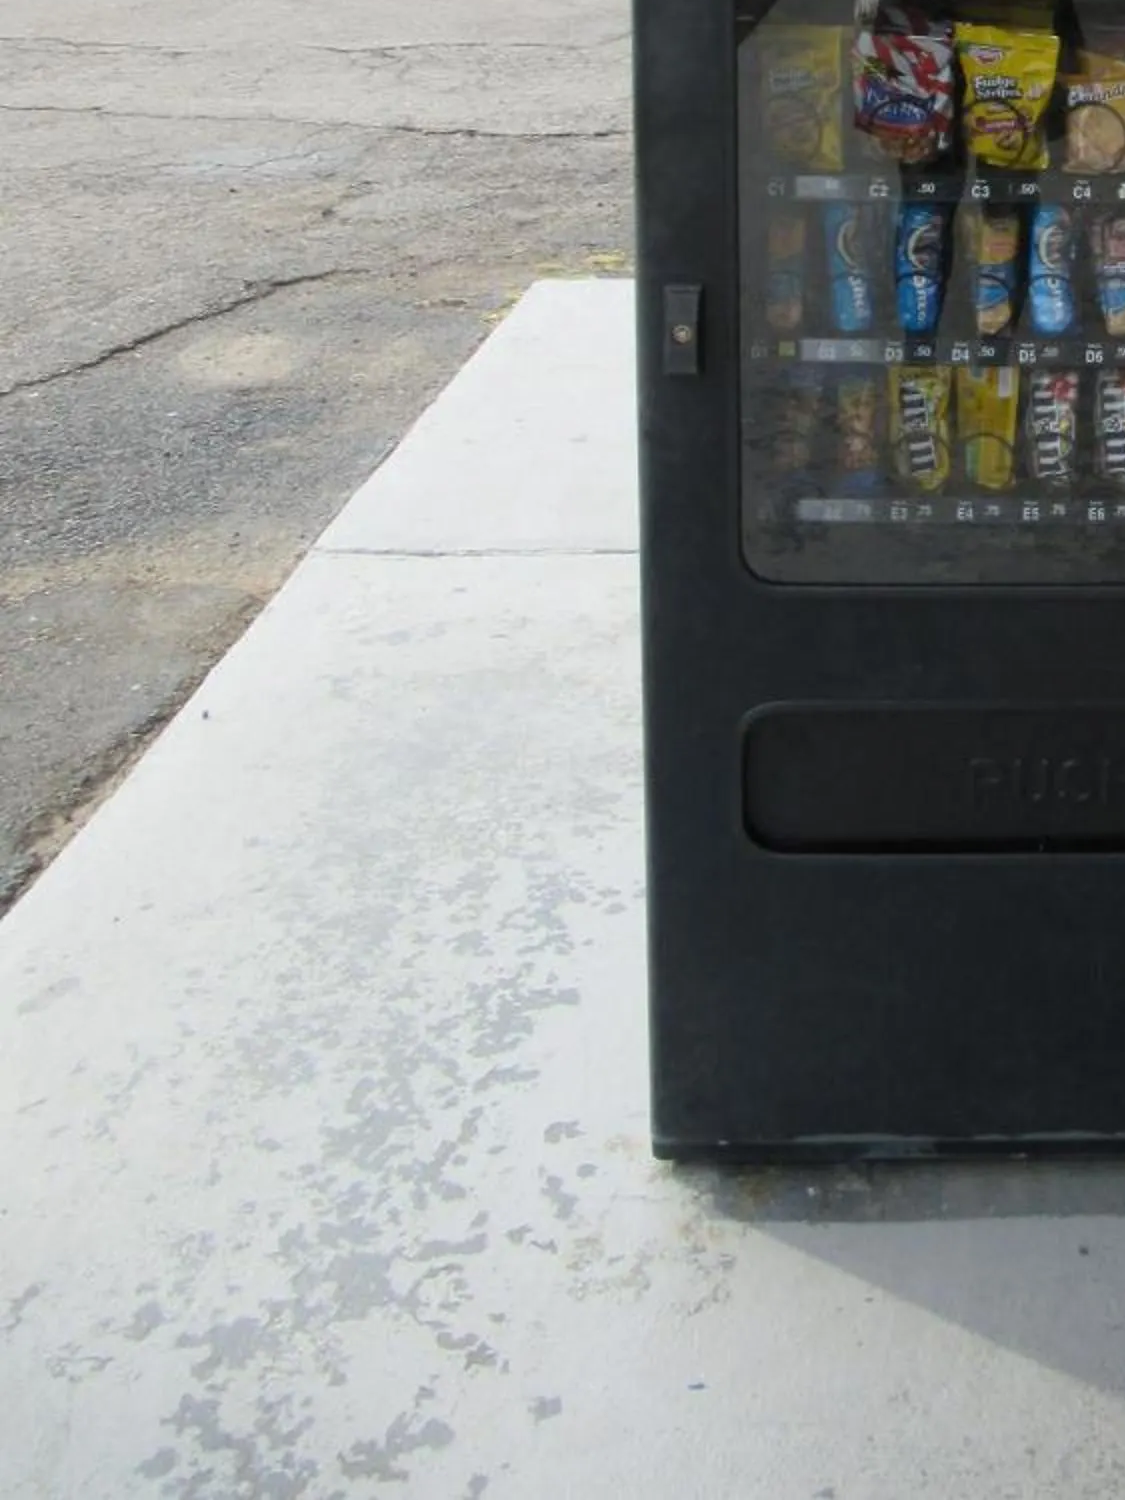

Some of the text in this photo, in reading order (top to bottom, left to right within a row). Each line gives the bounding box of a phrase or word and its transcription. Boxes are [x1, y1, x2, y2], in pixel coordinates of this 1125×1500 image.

[869, 184, 890, 198] C2
[970, 185, 990, 199] C3
[1073, 186, 1092, 200] C4
[884, 347, 904, 361] D3
[1018, 350, 1037, 364] D5
[1085, 350, 1104, 364] D6
[1023, 506, 1040, 521] E5
[1087, 506, 1106, 522] E6
